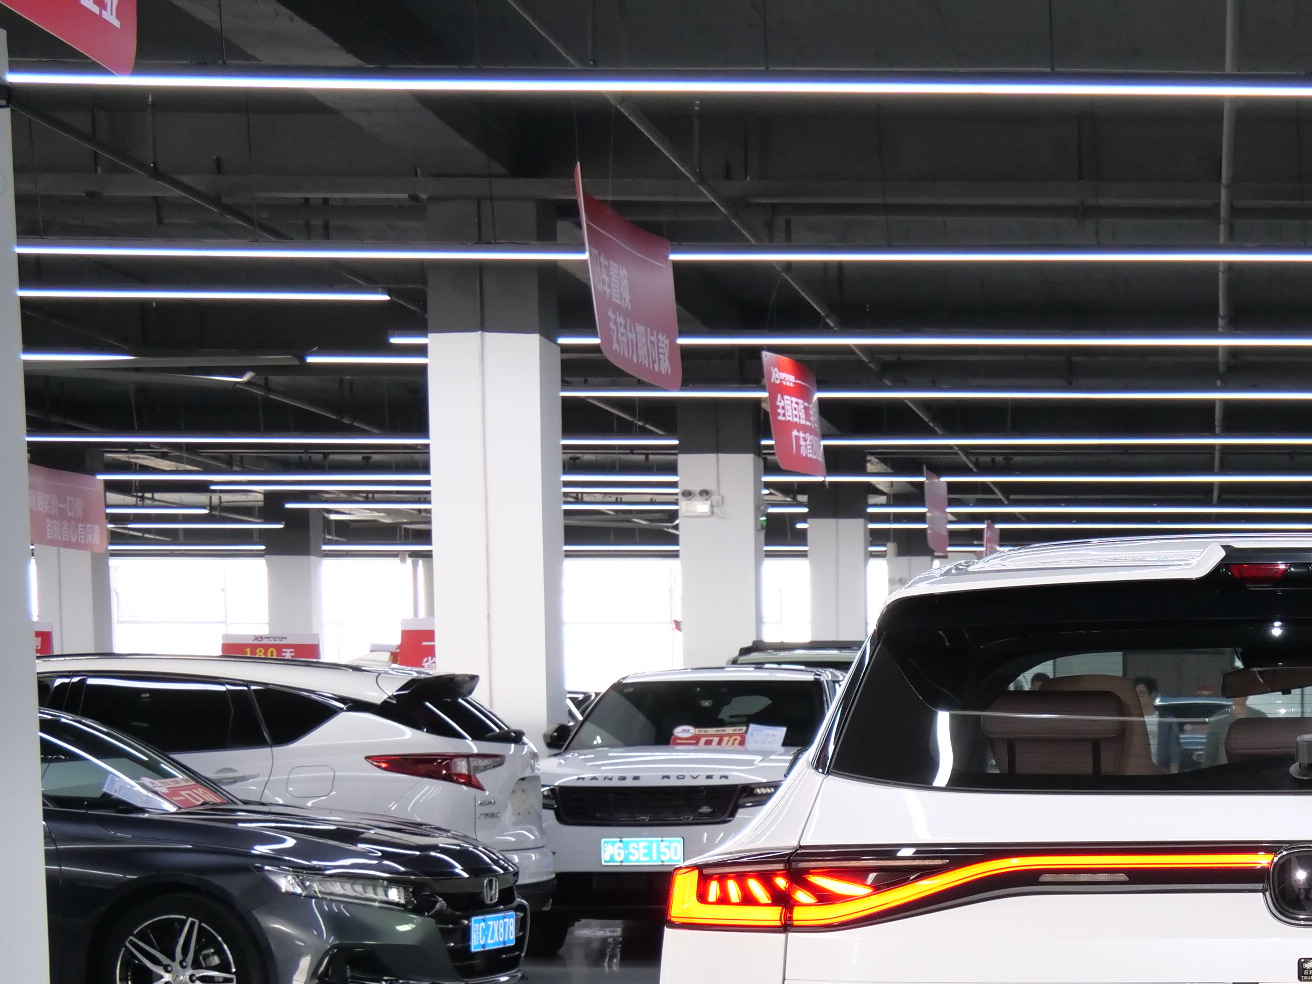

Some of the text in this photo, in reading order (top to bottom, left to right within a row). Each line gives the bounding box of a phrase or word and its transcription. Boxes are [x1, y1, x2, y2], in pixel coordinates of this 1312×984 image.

[607, 307, 671, 376] 支持分期付款
